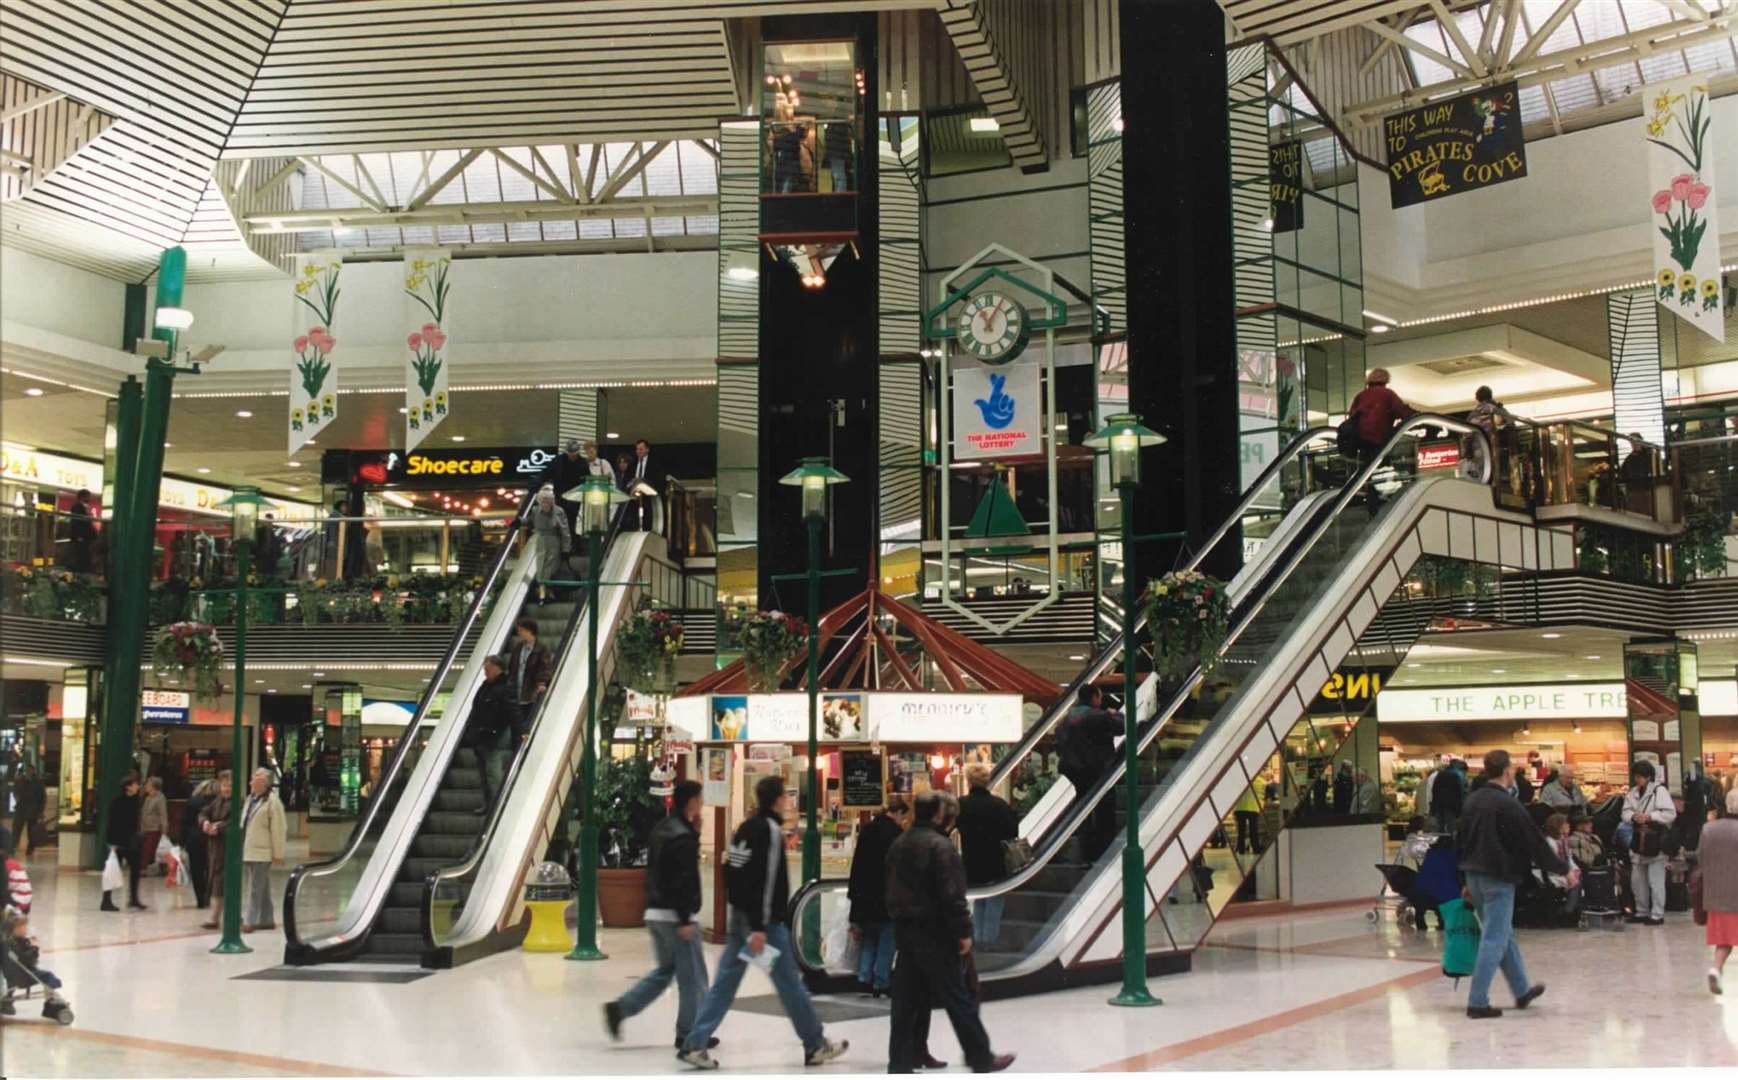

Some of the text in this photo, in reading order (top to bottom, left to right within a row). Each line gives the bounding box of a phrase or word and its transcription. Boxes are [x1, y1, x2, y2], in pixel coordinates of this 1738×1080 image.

[1386, 104, 1454, 135] THIS WAY
[1388, 137, 1406, 152] TO
[1391, 141, 1474, 181] PIRATES
[1463, 152, 1523, 183] COVE
[968, 431, 1026, 442] THE NATIONAL
[979, 441, 1014, 449] LOTTERY
[407, 455, 504, 475] Shoecare
[1431, 696, 1473, 713] THE
[1492, 693, 1566, 711] APPLE
